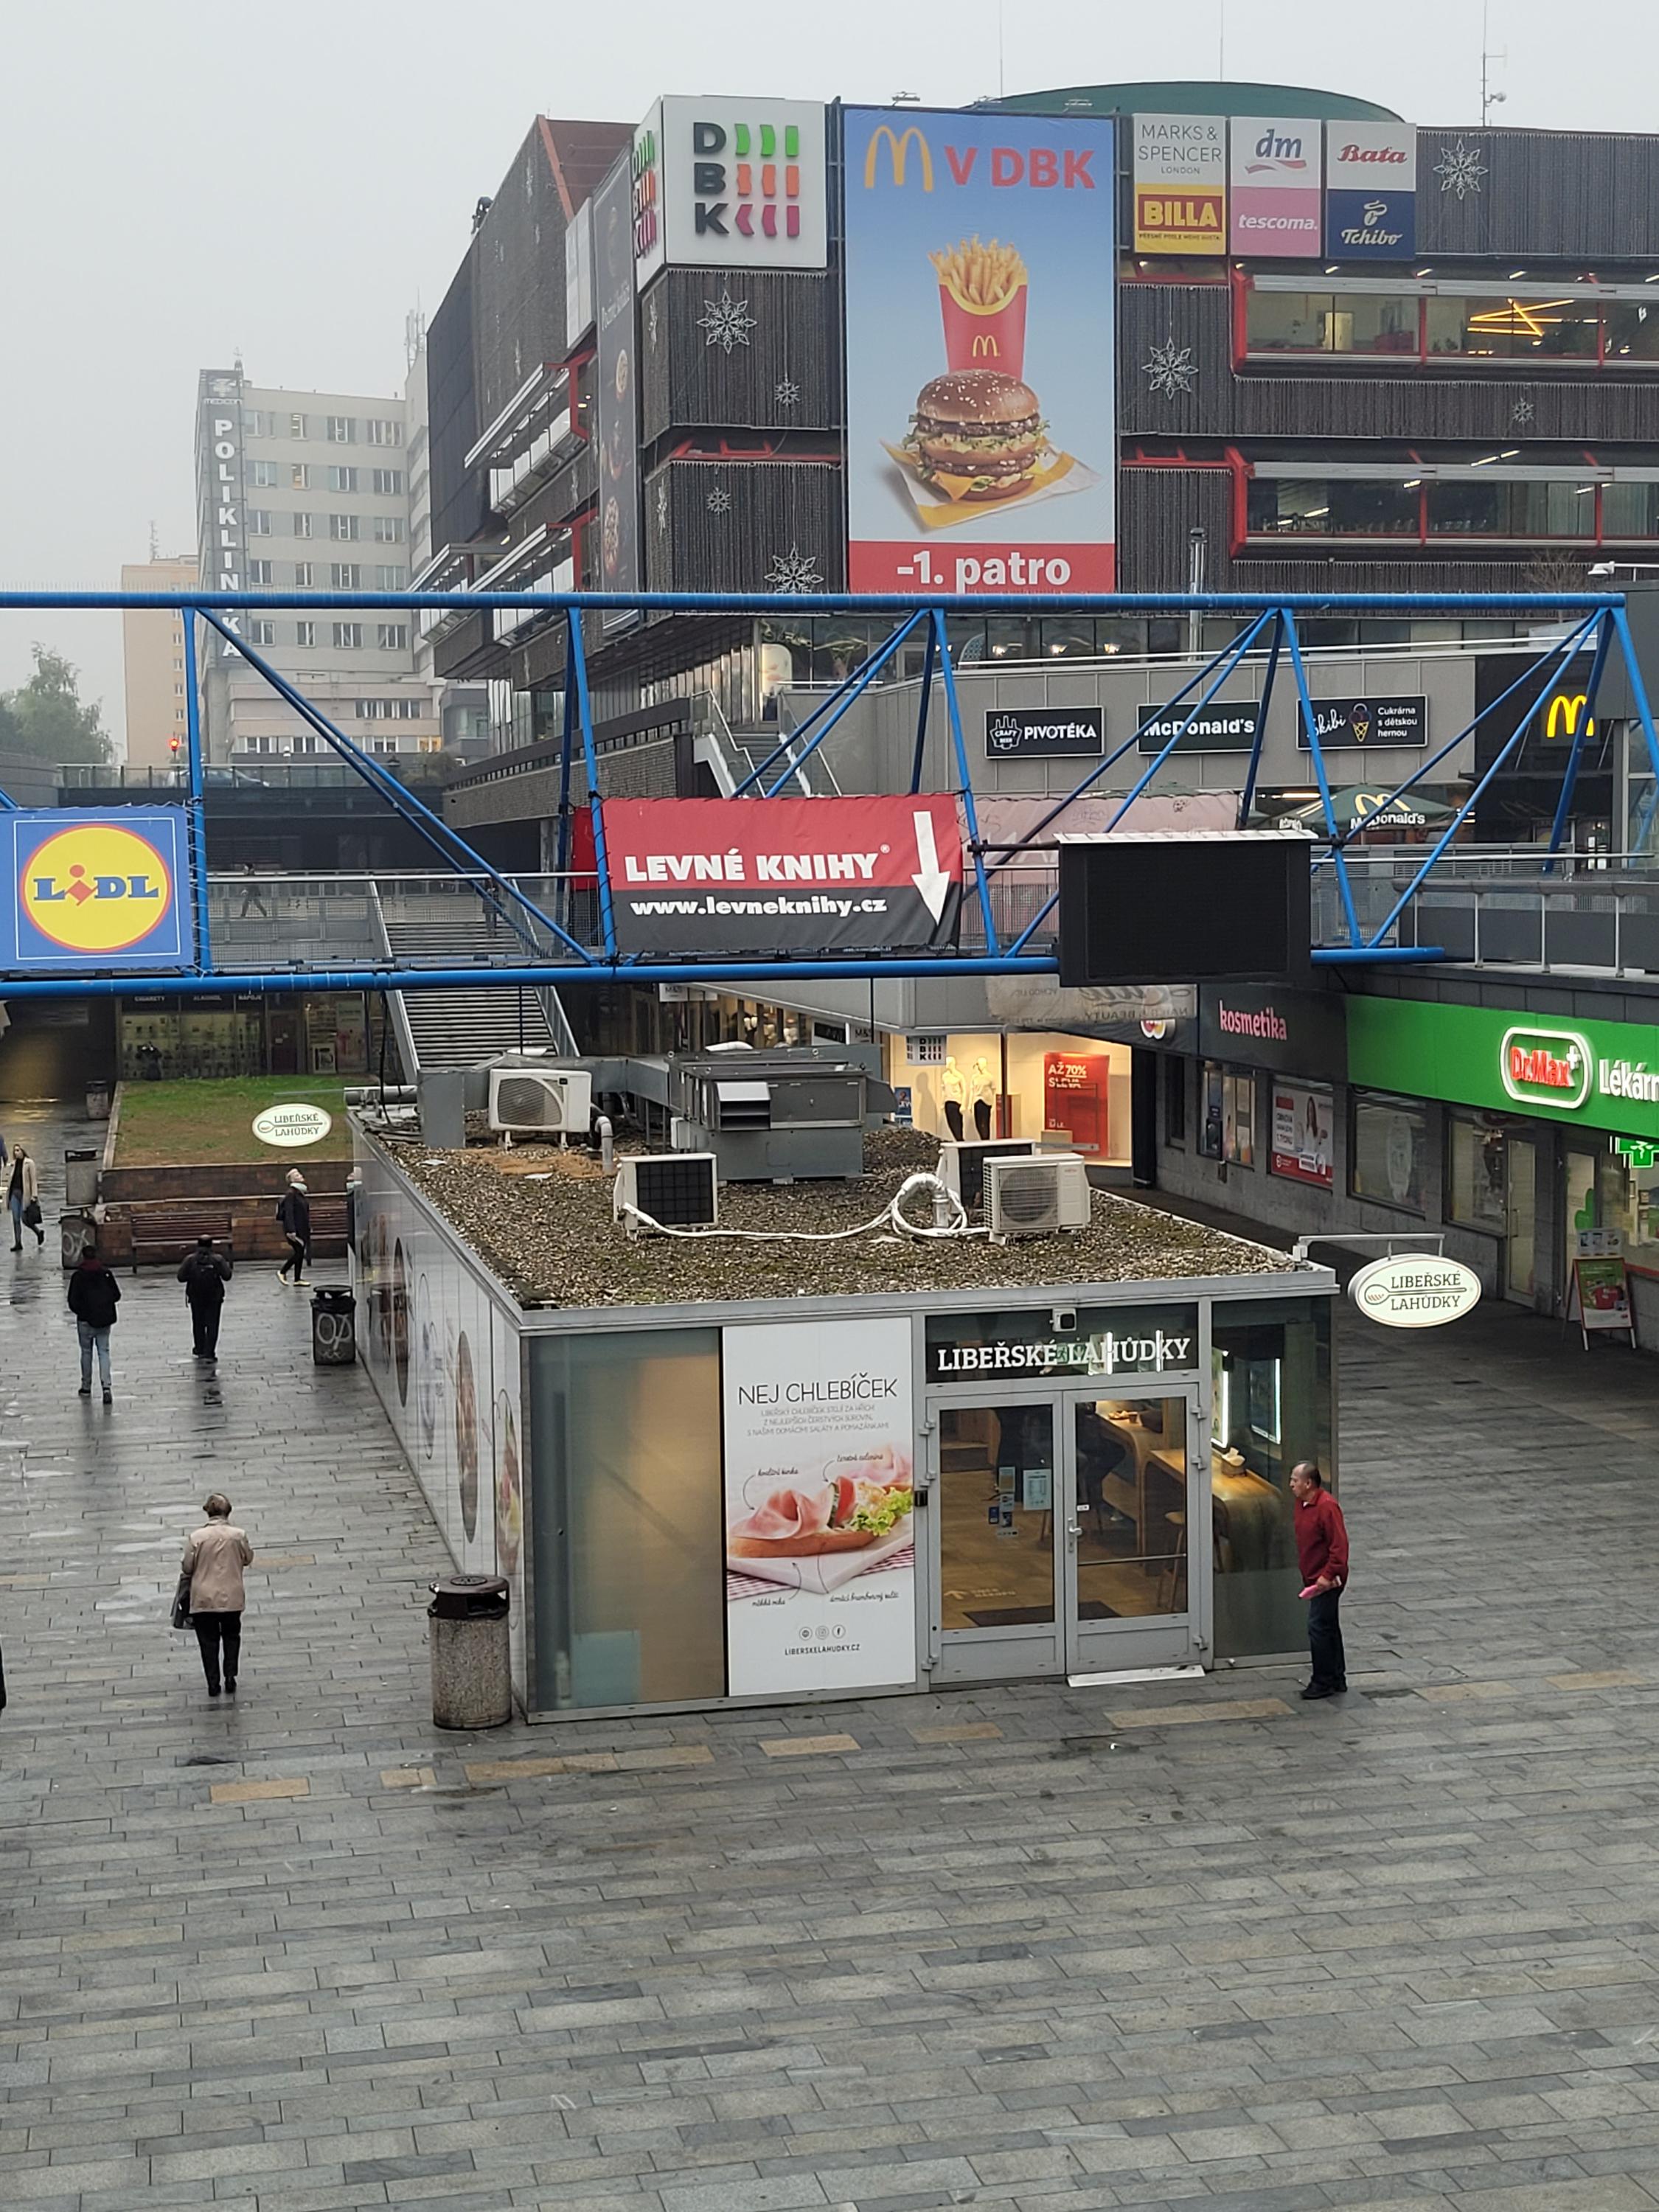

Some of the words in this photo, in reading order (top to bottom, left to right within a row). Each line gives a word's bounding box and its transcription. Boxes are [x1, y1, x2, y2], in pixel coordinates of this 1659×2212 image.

[1141, 124, 1203, 141] MARKS
[1206, 126, 1218, 141] &
[1255, 128, 1302, 159] dm
[1138, 146, 1222, 163] SPENCER
[945, 146, 978, 185] V
[991, 147, 1096, 189] DBK
[1161, 167, 1200, 175] LONDON
[1144, 201, 1219, 227] BILLA
[1341, 229, 1403, 246] Tchibo
[215, 419, 241, 657] POLIKLINKA
[956, 552, 1071, 593] patro
[1377, 706, 1416, 715] Cukrárna
[1024, 722, 1097, 740] PIVOTÉKA
[1307, 709, 1347, 738] kibi
[1377, 728, 1408, 737] hernou
[624, 847, 745, 882] LEVNÉ
[630, 894, 887, 917] www.levneknihy.cz
[1219, 999, 1287, 1040] kosmetika
[1048, 1061, 1064, 1074] AŽ
[1065, 1064, 1087, 1076] 70%
[274, 1113, 319, 1123] LIBEŘSKÉ
[1391, 1270, 1461, 1289] LIBEŘSKÉ
[1391, 1295, 1462, 1311] LAHŮDKY
[938, 1340, 1057, 1371] LIBEŘSKÉ
[1068, 1336, 1191, 1365] LAHŮDKY
[739, 1384, 779, 1405] NEJ
[786, 1372, 898, 1402] CHLEBÍČEK
[785, 1644, 860, 1655] LIBERSKELAHUDKY.CZ
